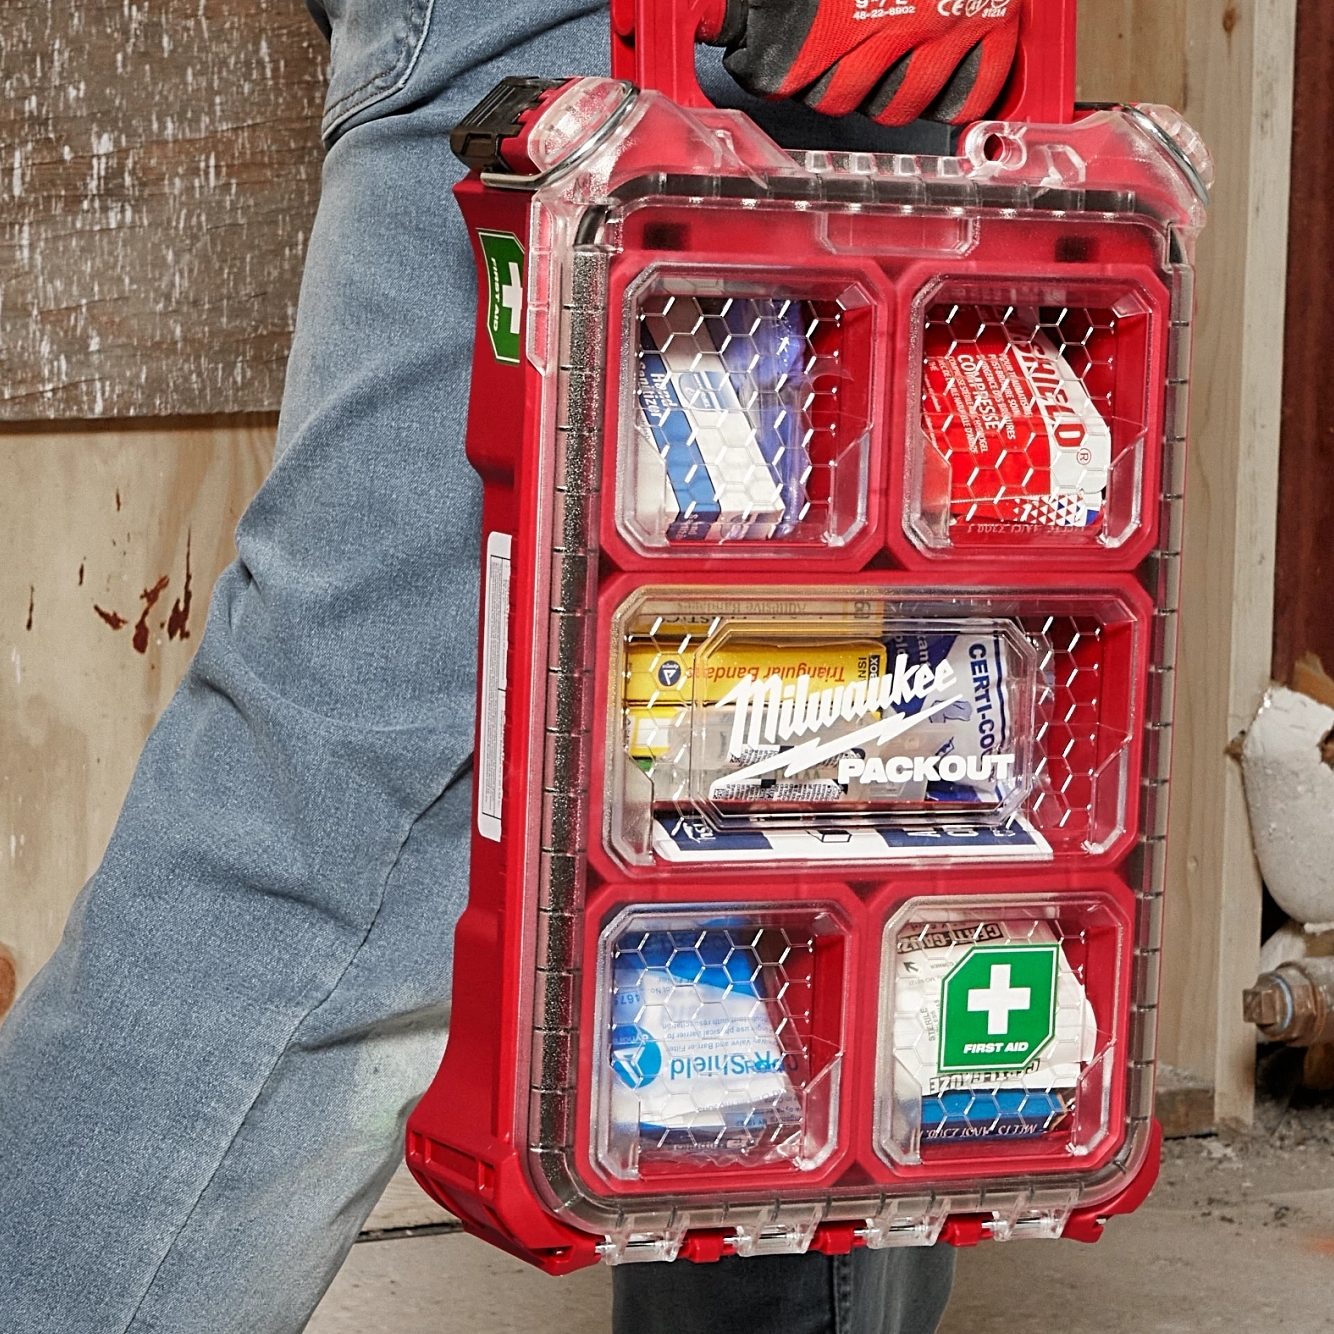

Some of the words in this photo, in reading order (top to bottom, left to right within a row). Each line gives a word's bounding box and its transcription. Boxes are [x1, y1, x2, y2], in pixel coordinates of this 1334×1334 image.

[853, 5, 916, 20] 48-22-8902
[491, 257, 500, 302] FIRST
[956, 353, 998, 430] COMPRESSE
[857, 657, 867, 681] NSI
[714, 653, 958, 759] Milwaukee
[838, 754, 1015, 784] PACKOUT
[921, 1006, 936, 1042] STERILE
[963, 1042, 1004, 1054] FIRST
[1005, 1041, 1029, 1053] AID
[669, 1050, 746, 1080] Shield
